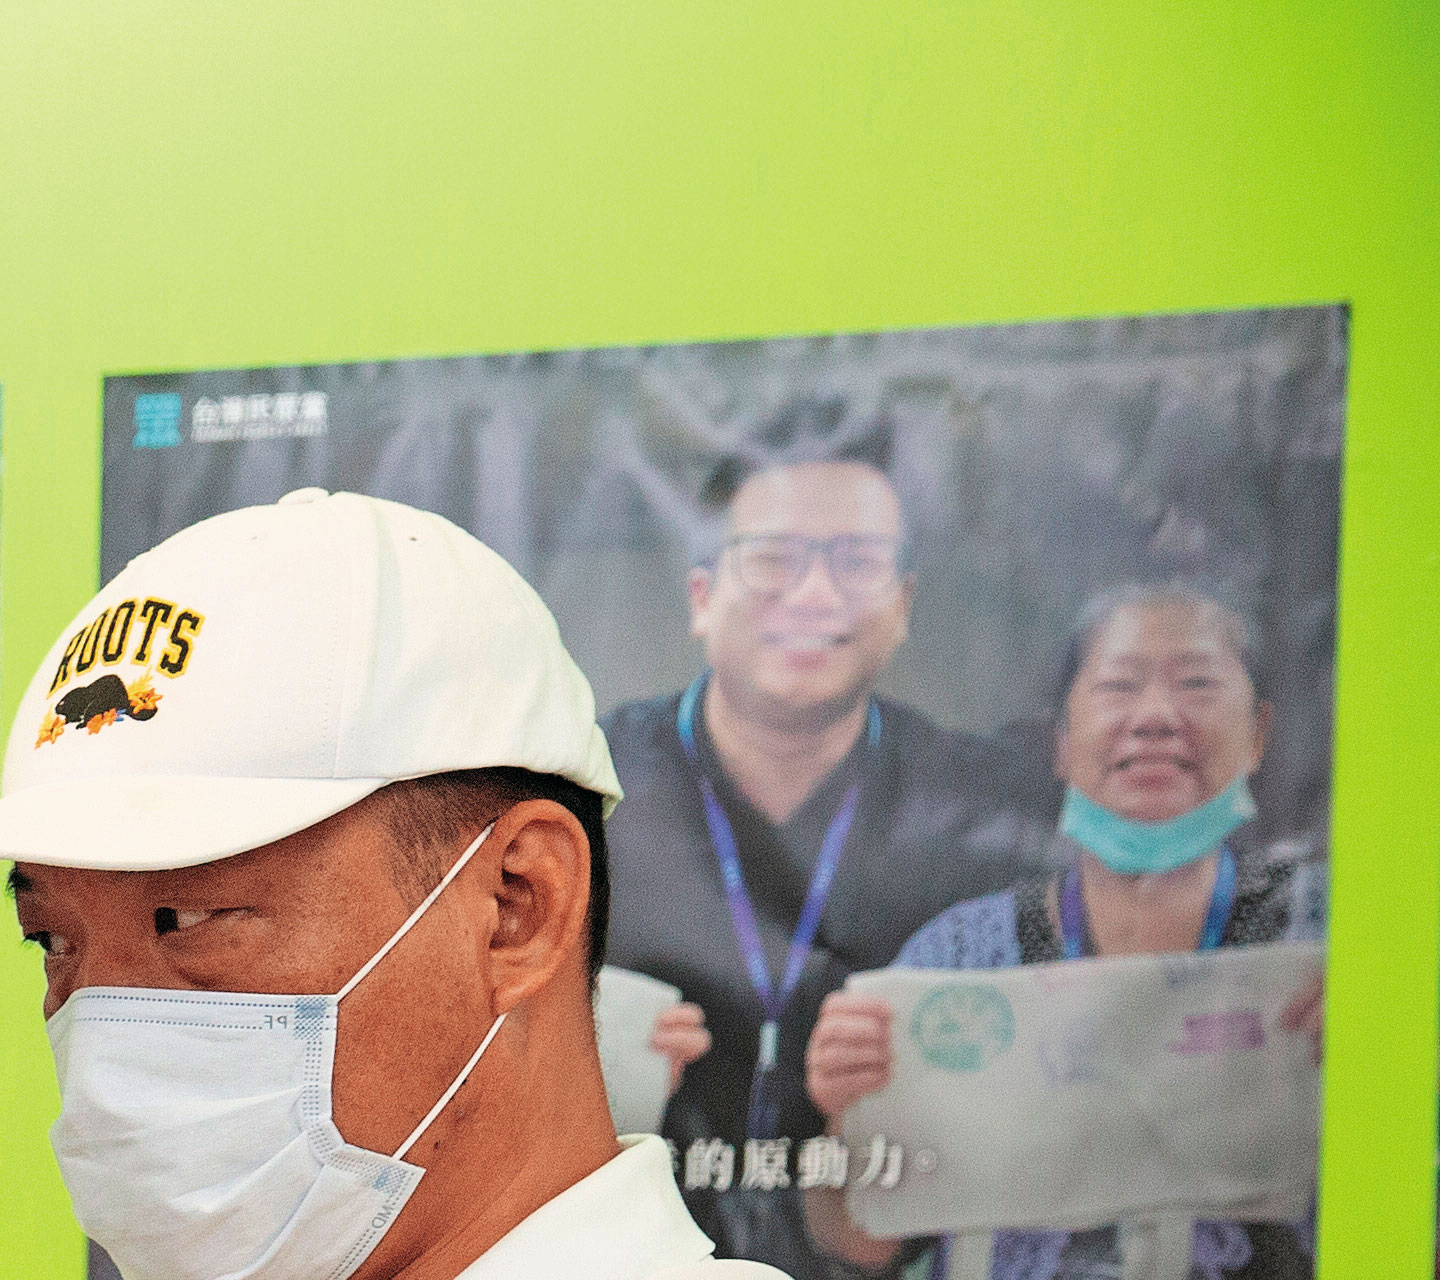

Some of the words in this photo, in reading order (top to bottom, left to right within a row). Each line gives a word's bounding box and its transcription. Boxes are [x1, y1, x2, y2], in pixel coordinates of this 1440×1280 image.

[46, 597, 206, 699] ROOTS
[665, 1133, 936, 1193] 的原動力。
